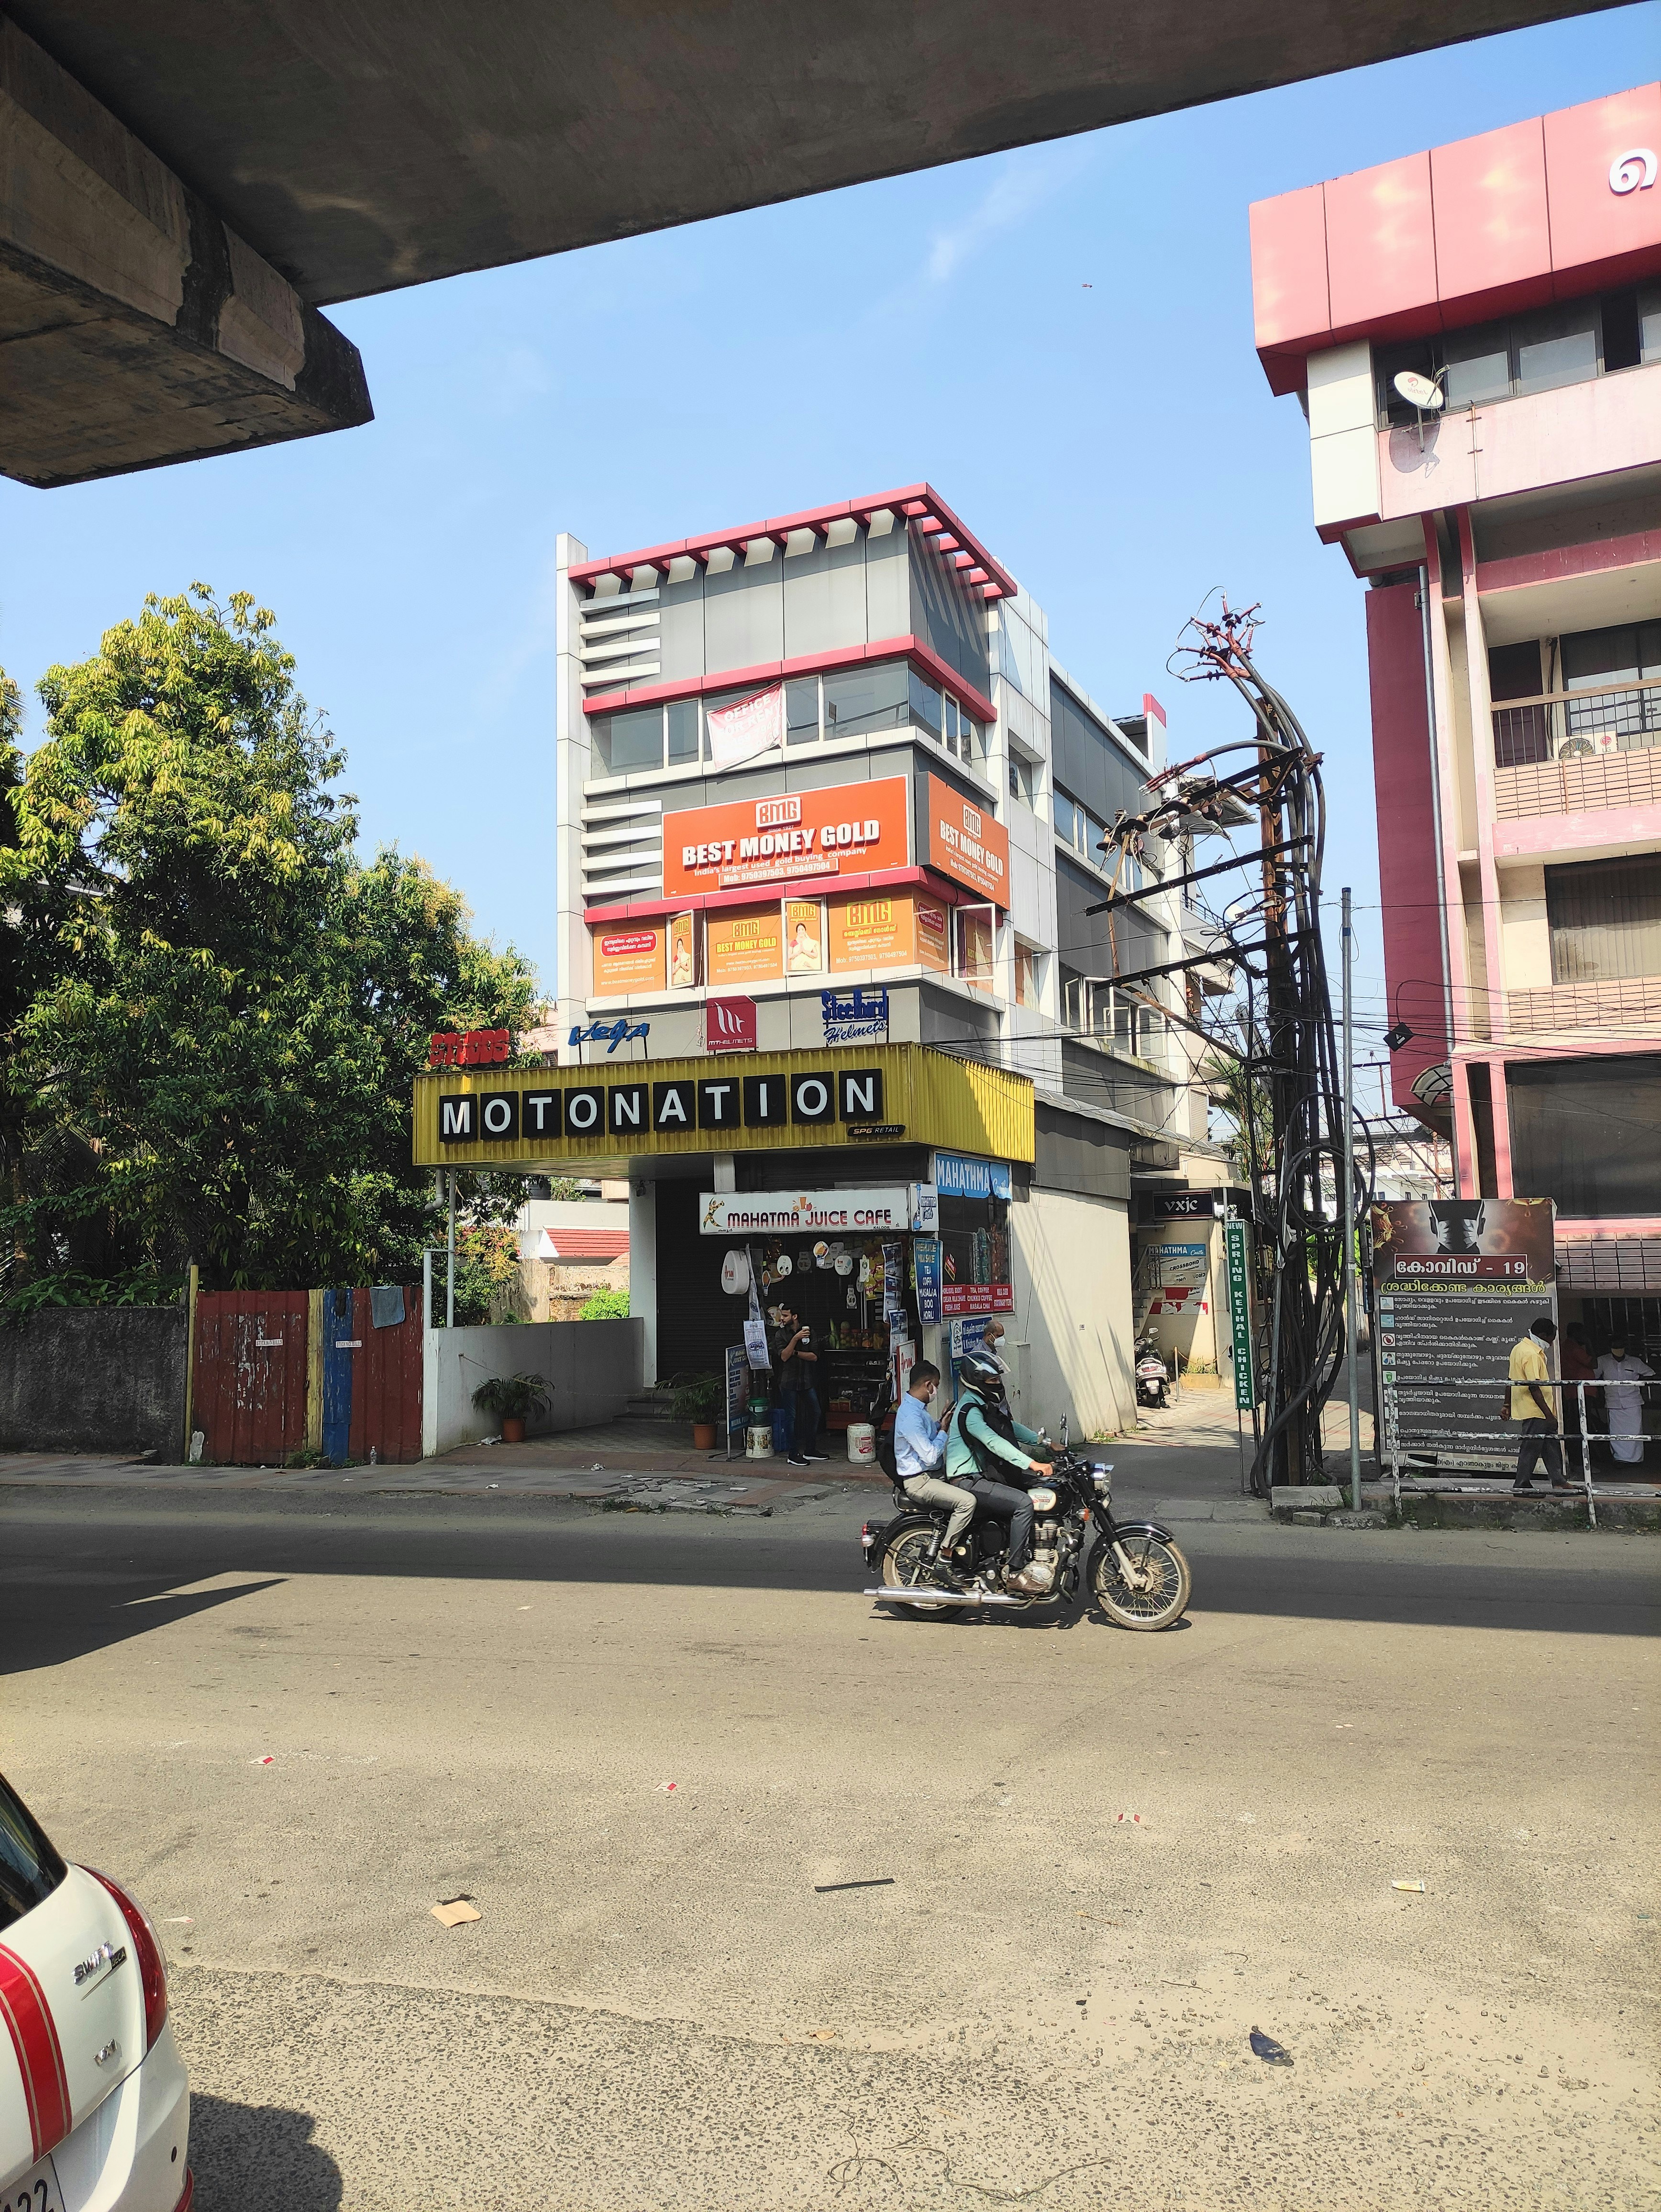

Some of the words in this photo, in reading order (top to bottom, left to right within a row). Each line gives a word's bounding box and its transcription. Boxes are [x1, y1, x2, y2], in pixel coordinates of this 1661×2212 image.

[719, 720, 744, 736] FOR
[748, 702, 781, 727] RENT
[724, 693, 771, 721] OFFICE
[759, 800, 797, 824] BMG
[682, 839, 737, 868] BEST
[740, 828, 816, 861] MONEY
[820, 819, 880, 850] GOLD
[940, 818, 959, 849] BEST
[960, 832, 985, 864] MONEY
[986, 850, 1003, 877] GOLD
[694, 866, 720, 876] India's
[721, 863, 749, 873] largest
[751, 860, 770, 868] used
[775, 856, 793, 866] gold
[795, 853, 823, 863] buying
[827, 847, 868, 859] company
[723, 874, 741, 884] Mob:
[741, 868, 785, 881] 9750397503,
[787, 861, 831, 874] 9750497504
[850, 900, 888, 925] BMG
[734, 921, 758, 937] BMG
[717, 941, 734, 953] BEST
[735, 939, 757, 951] MONEY
[759, 937, 776, 948] GOLD
[849, 953, 877, 962] 9750397503,
[821, 986, 887, 1020] Steelbird
[823, 1020, 887, 1045] Helmets
[443, 1077, 874, 1135] MOTONATION
[937, 1159, 991, 1193] MAHATHMA
[920, 1197, 936, 1206] MAHATMA
[727, 1212, 799, 1228] MAHATMA
[805, 1210, 848, 1227] JUICE
[853, 1209, 892, 1225] CAFE
[1169, 1260, 1199, 1271] CROSSBOND
[1231, 1235, 1242, 1282] SPRING
[1396, 1258, 1481, 1274] കോവിഡ്
[1503, 1261, 1526, 1275] 19
[1381, 1279, 1467, 1294] ശ്രദ്ധിക്കേണ്ട
[1472, 1280, 1546, 1296] കാര്യങ്ങൾ
[1234, 1291, 1245, 1338] KETHAL
[1455, 1316, 1487, 1324] ഉപയോഗിച്ച്
[900, 1352, 913, 1371] Arun
[1237, 1348, 1250, 1404] CHICKEN
[1401, 1439, 1425, 1448] സർക്കാർ
[1426, 1442, 1453, 1450] നൽകുന്ന
[1456, 1460, 1494, 1469] എറണാകുളം
[1495, 1461, 1509, 1471] ജില്ലാ
